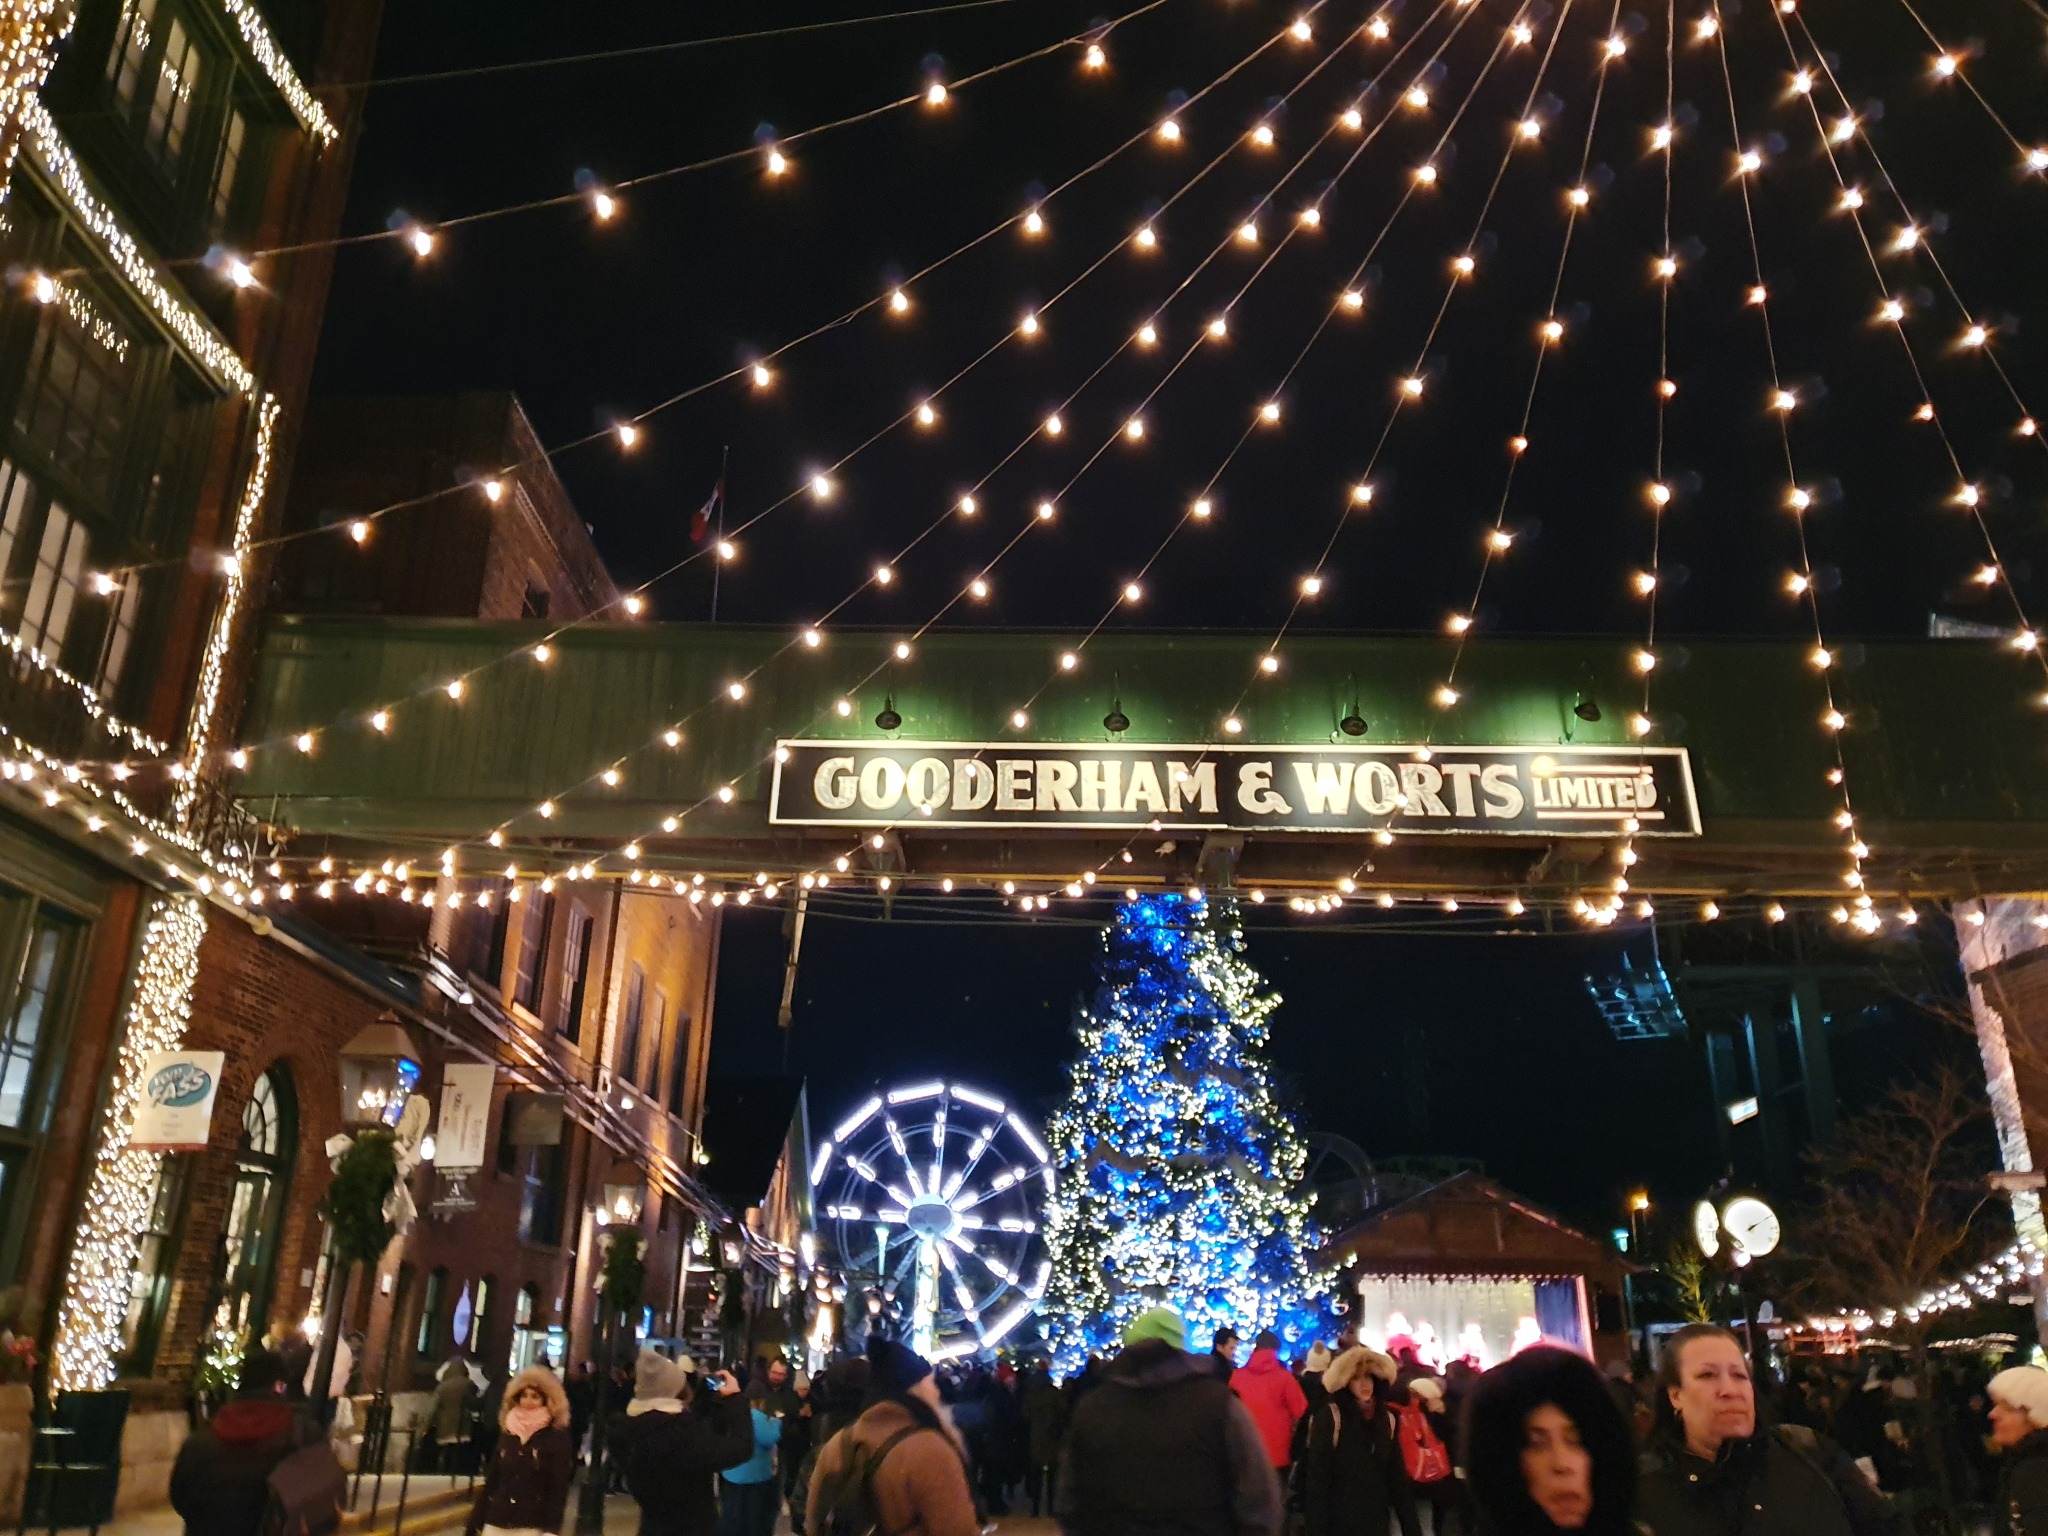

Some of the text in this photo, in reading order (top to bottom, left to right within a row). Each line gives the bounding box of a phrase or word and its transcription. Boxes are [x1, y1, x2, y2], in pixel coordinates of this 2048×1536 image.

[813, 755, 1658, 819] GOODERHAM & WORTS LIMITED
